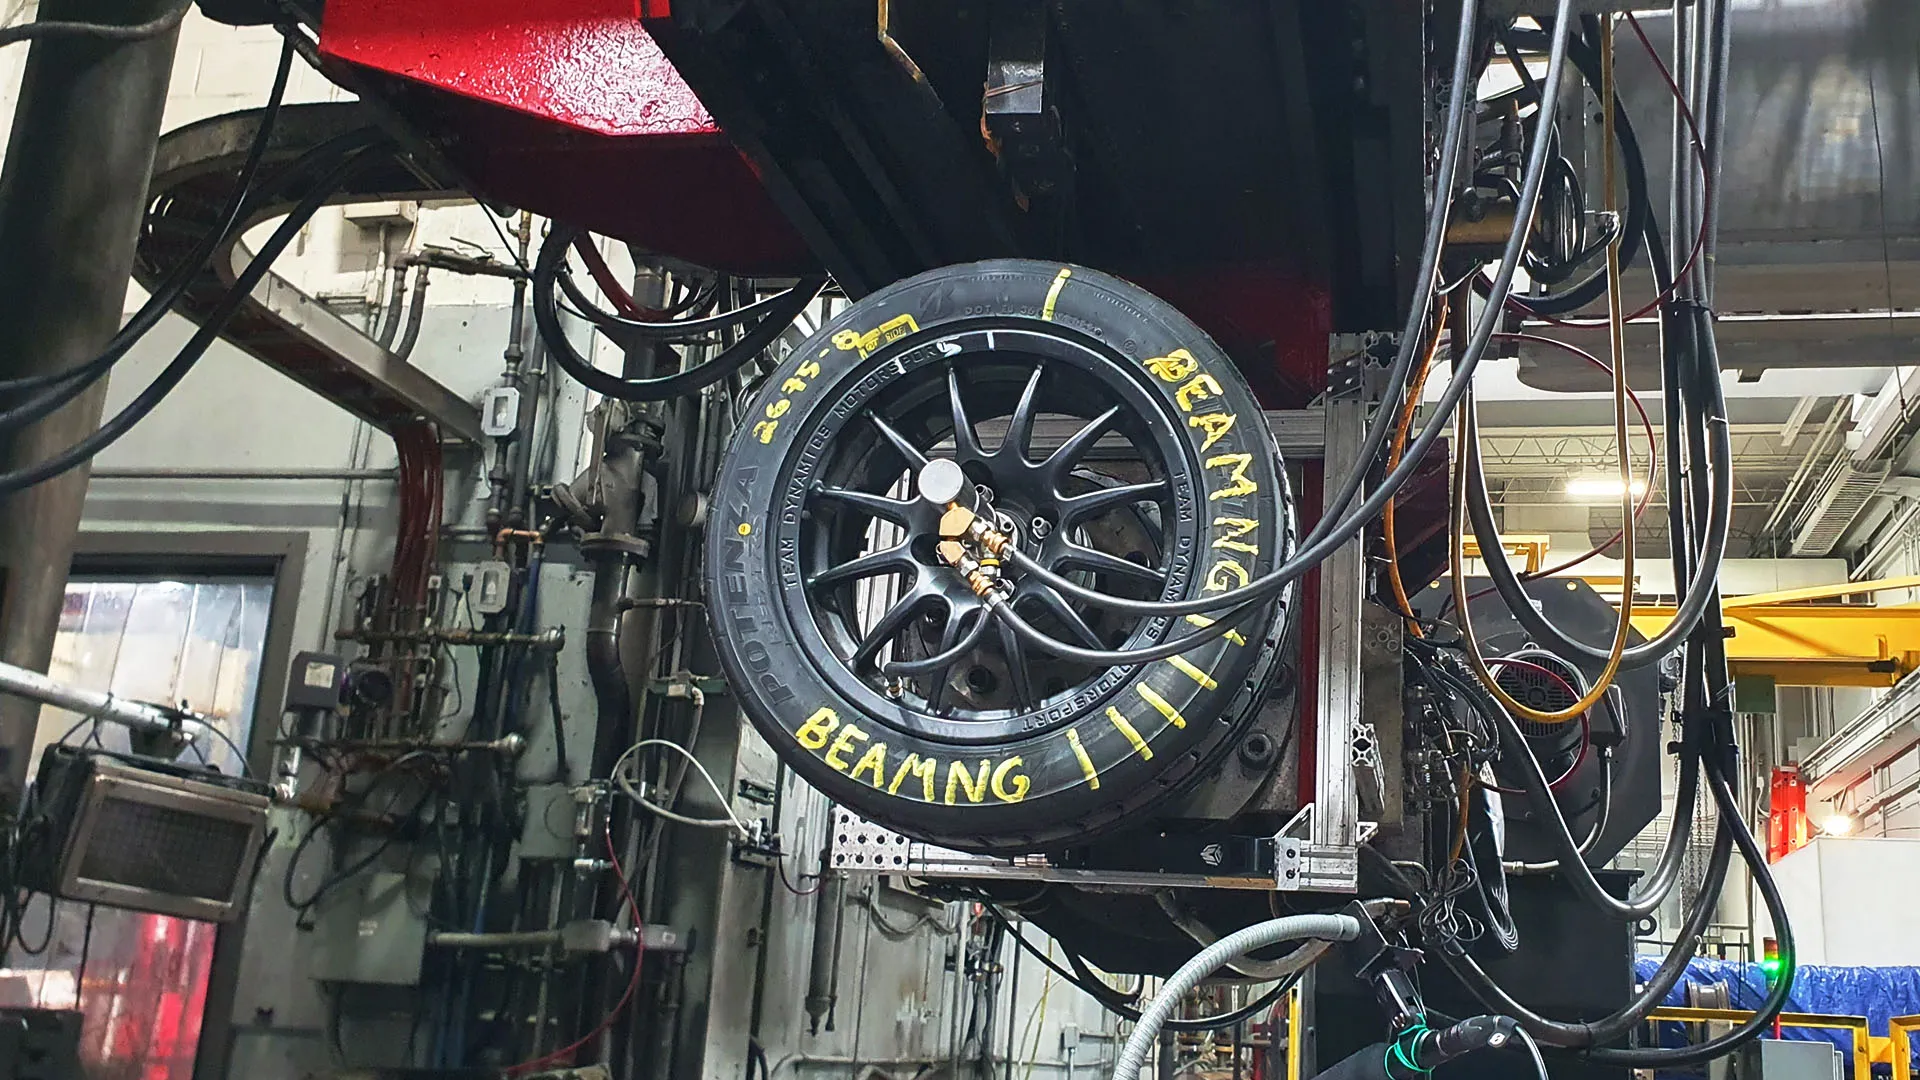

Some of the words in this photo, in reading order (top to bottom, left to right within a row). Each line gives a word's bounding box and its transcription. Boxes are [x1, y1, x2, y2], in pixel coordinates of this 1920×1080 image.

[782, 425, 832, 526] DYNAMICS
[1142, 348, 1260, 592] BEAMNG
[1171, 469, 1195, 523] TEAM
[723, 465, 797, 705] POTENZA
[780, 537, 799, 592] TEAM
[795, 706, 1031, 806] BEAMNG
